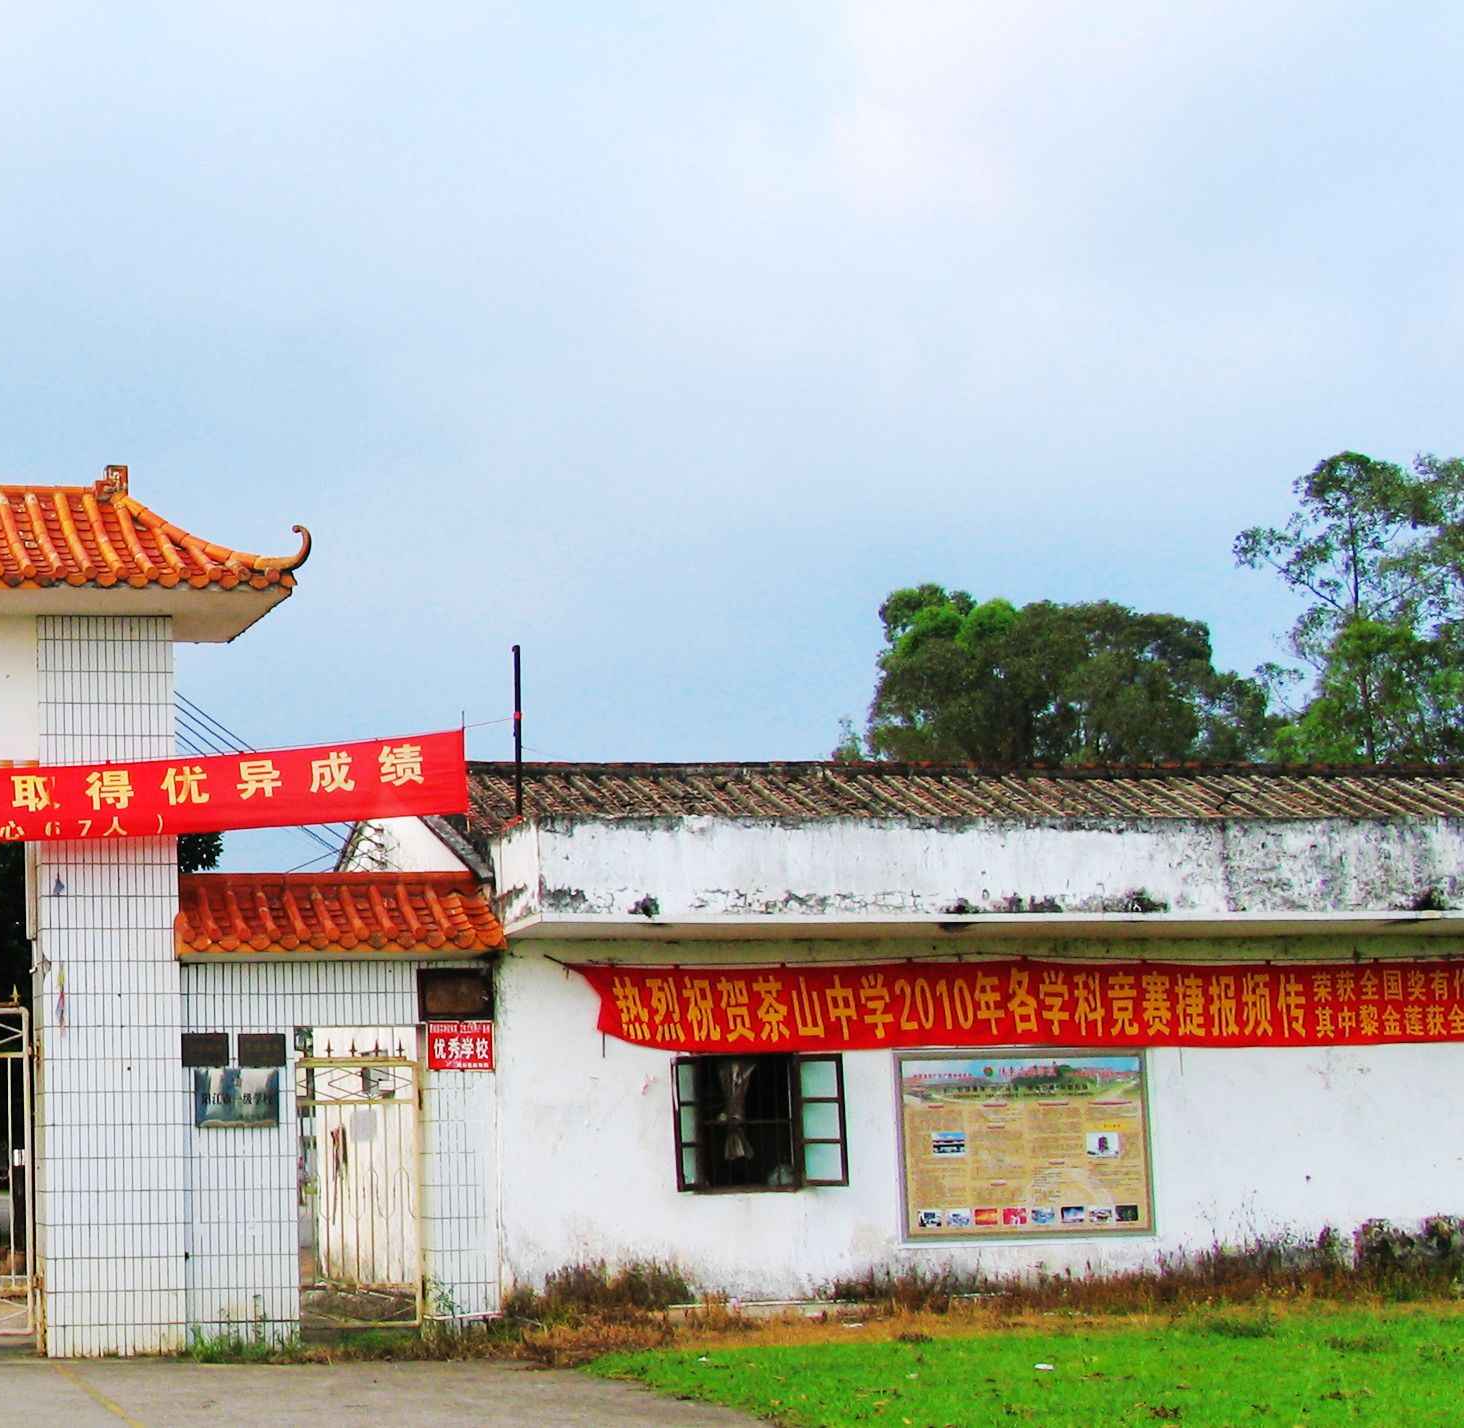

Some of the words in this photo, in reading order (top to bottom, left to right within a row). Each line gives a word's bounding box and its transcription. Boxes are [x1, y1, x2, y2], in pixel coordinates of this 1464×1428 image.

[613, 969, 1306, 1042] 热烈祝贺茶山中学2010年各学科竞赛捷报频传
[434, 1037, 489, 1060] 优秀学校
